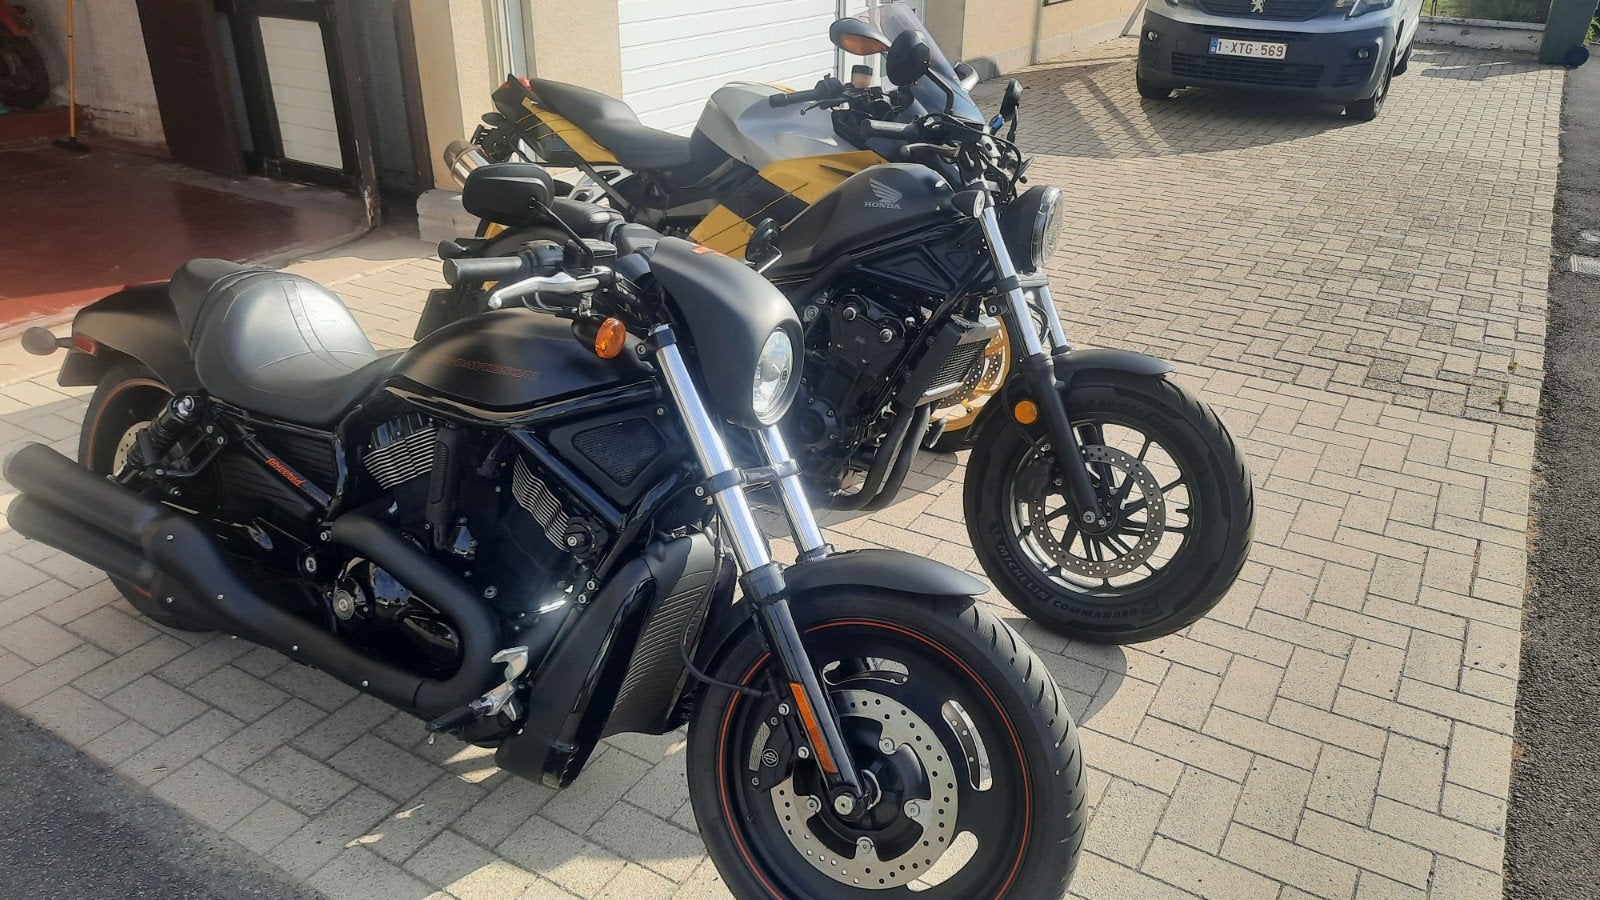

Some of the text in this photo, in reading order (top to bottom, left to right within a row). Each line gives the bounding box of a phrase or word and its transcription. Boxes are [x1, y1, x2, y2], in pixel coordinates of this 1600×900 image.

[864, 201, 901, 210] HONDA
[999, 545, 1138, 619] MICHELIN COMMANDER
